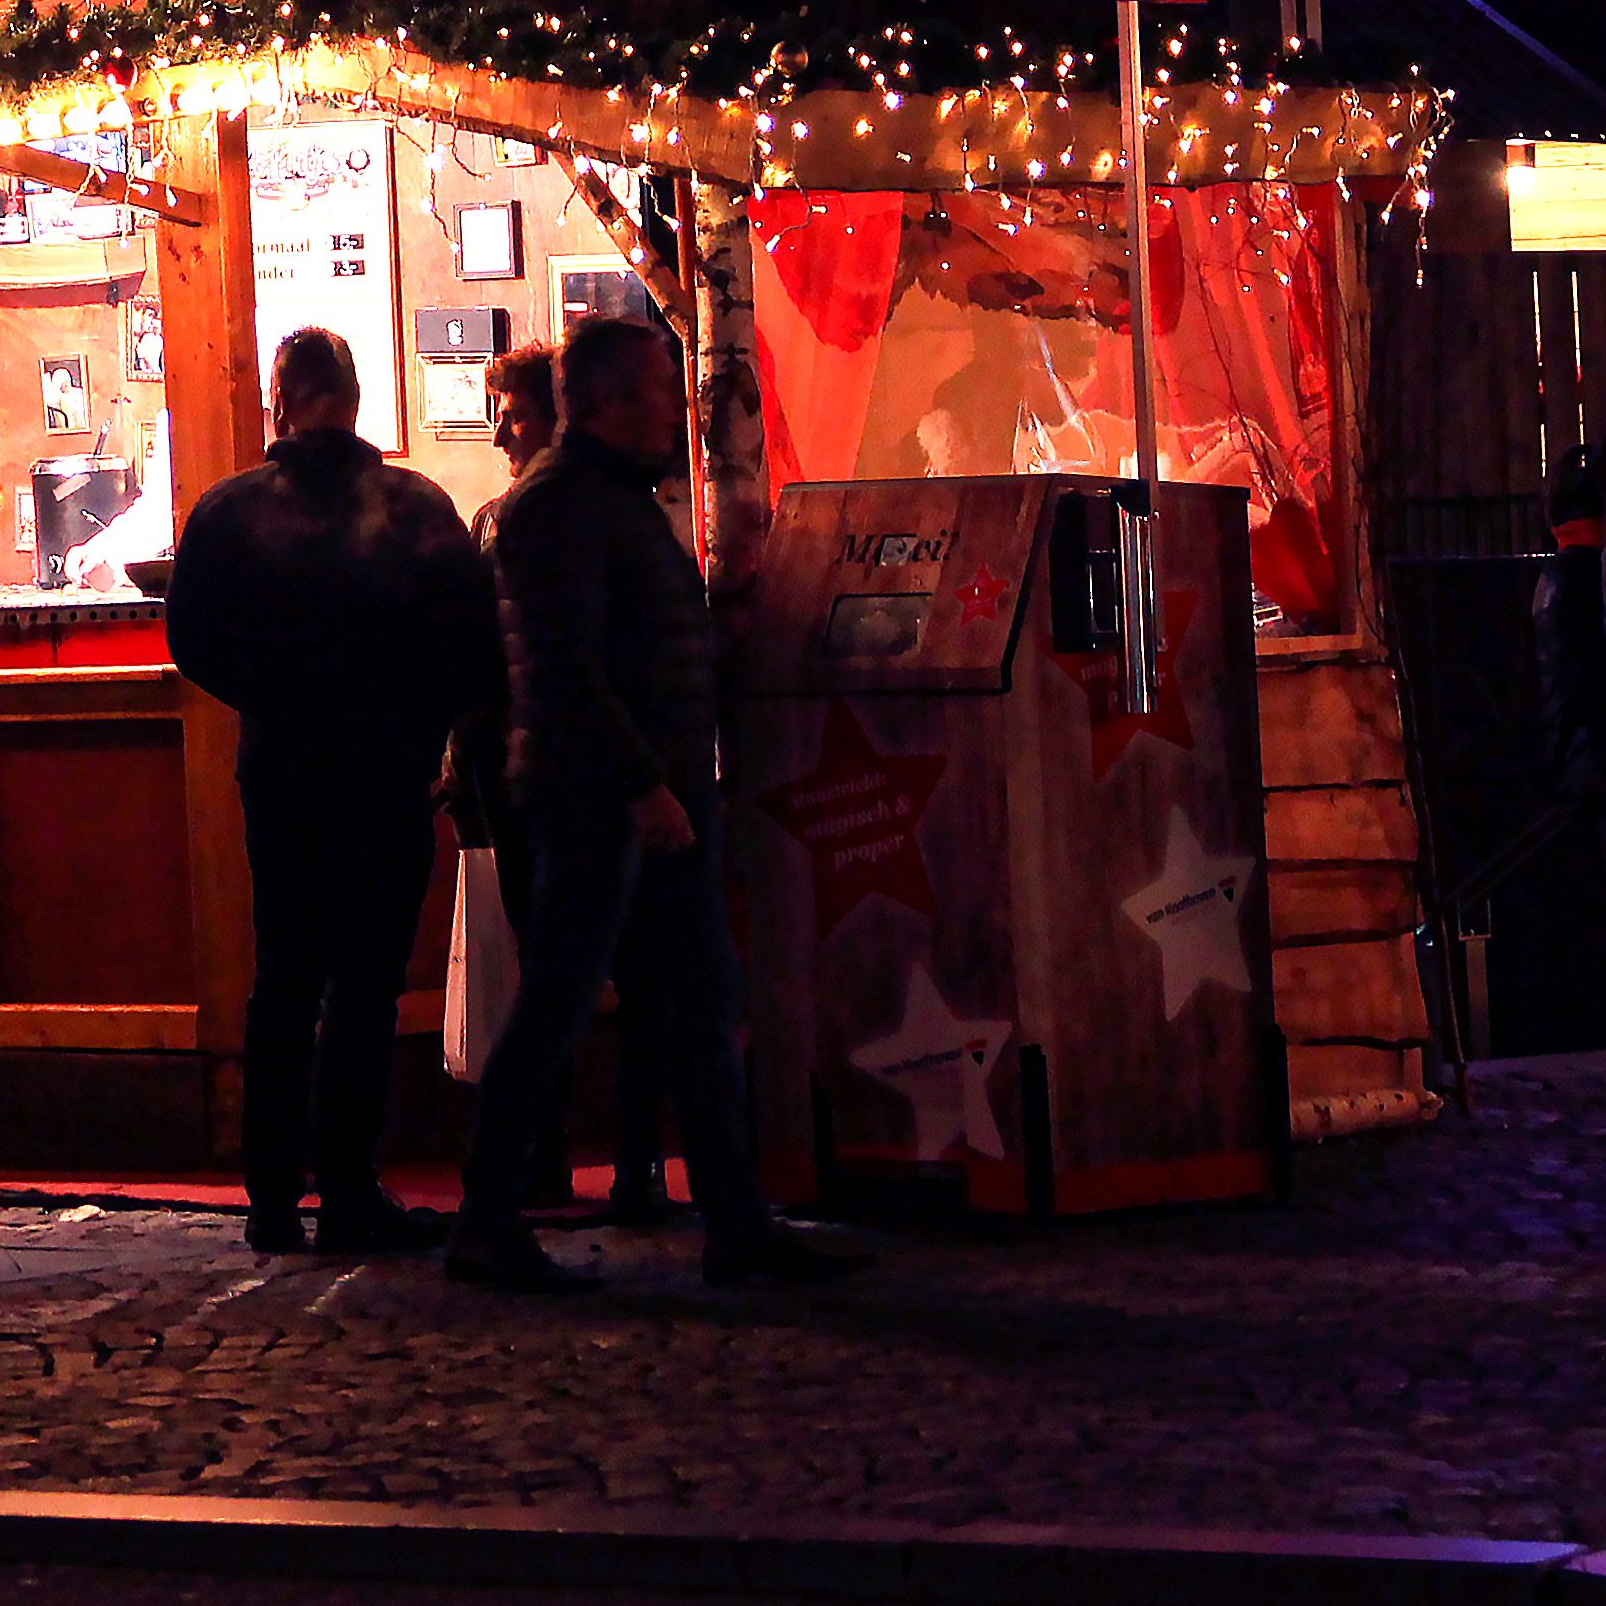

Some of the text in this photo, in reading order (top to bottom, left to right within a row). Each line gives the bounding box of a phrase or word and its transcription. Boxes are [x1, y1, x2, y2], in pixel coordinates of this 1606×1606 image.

[254, 237, 309, 254] ormaal
[257, 265, 295, 281] nder
[803, 799, 892, 838] magisch
[834, 835, 905, 873] proper
